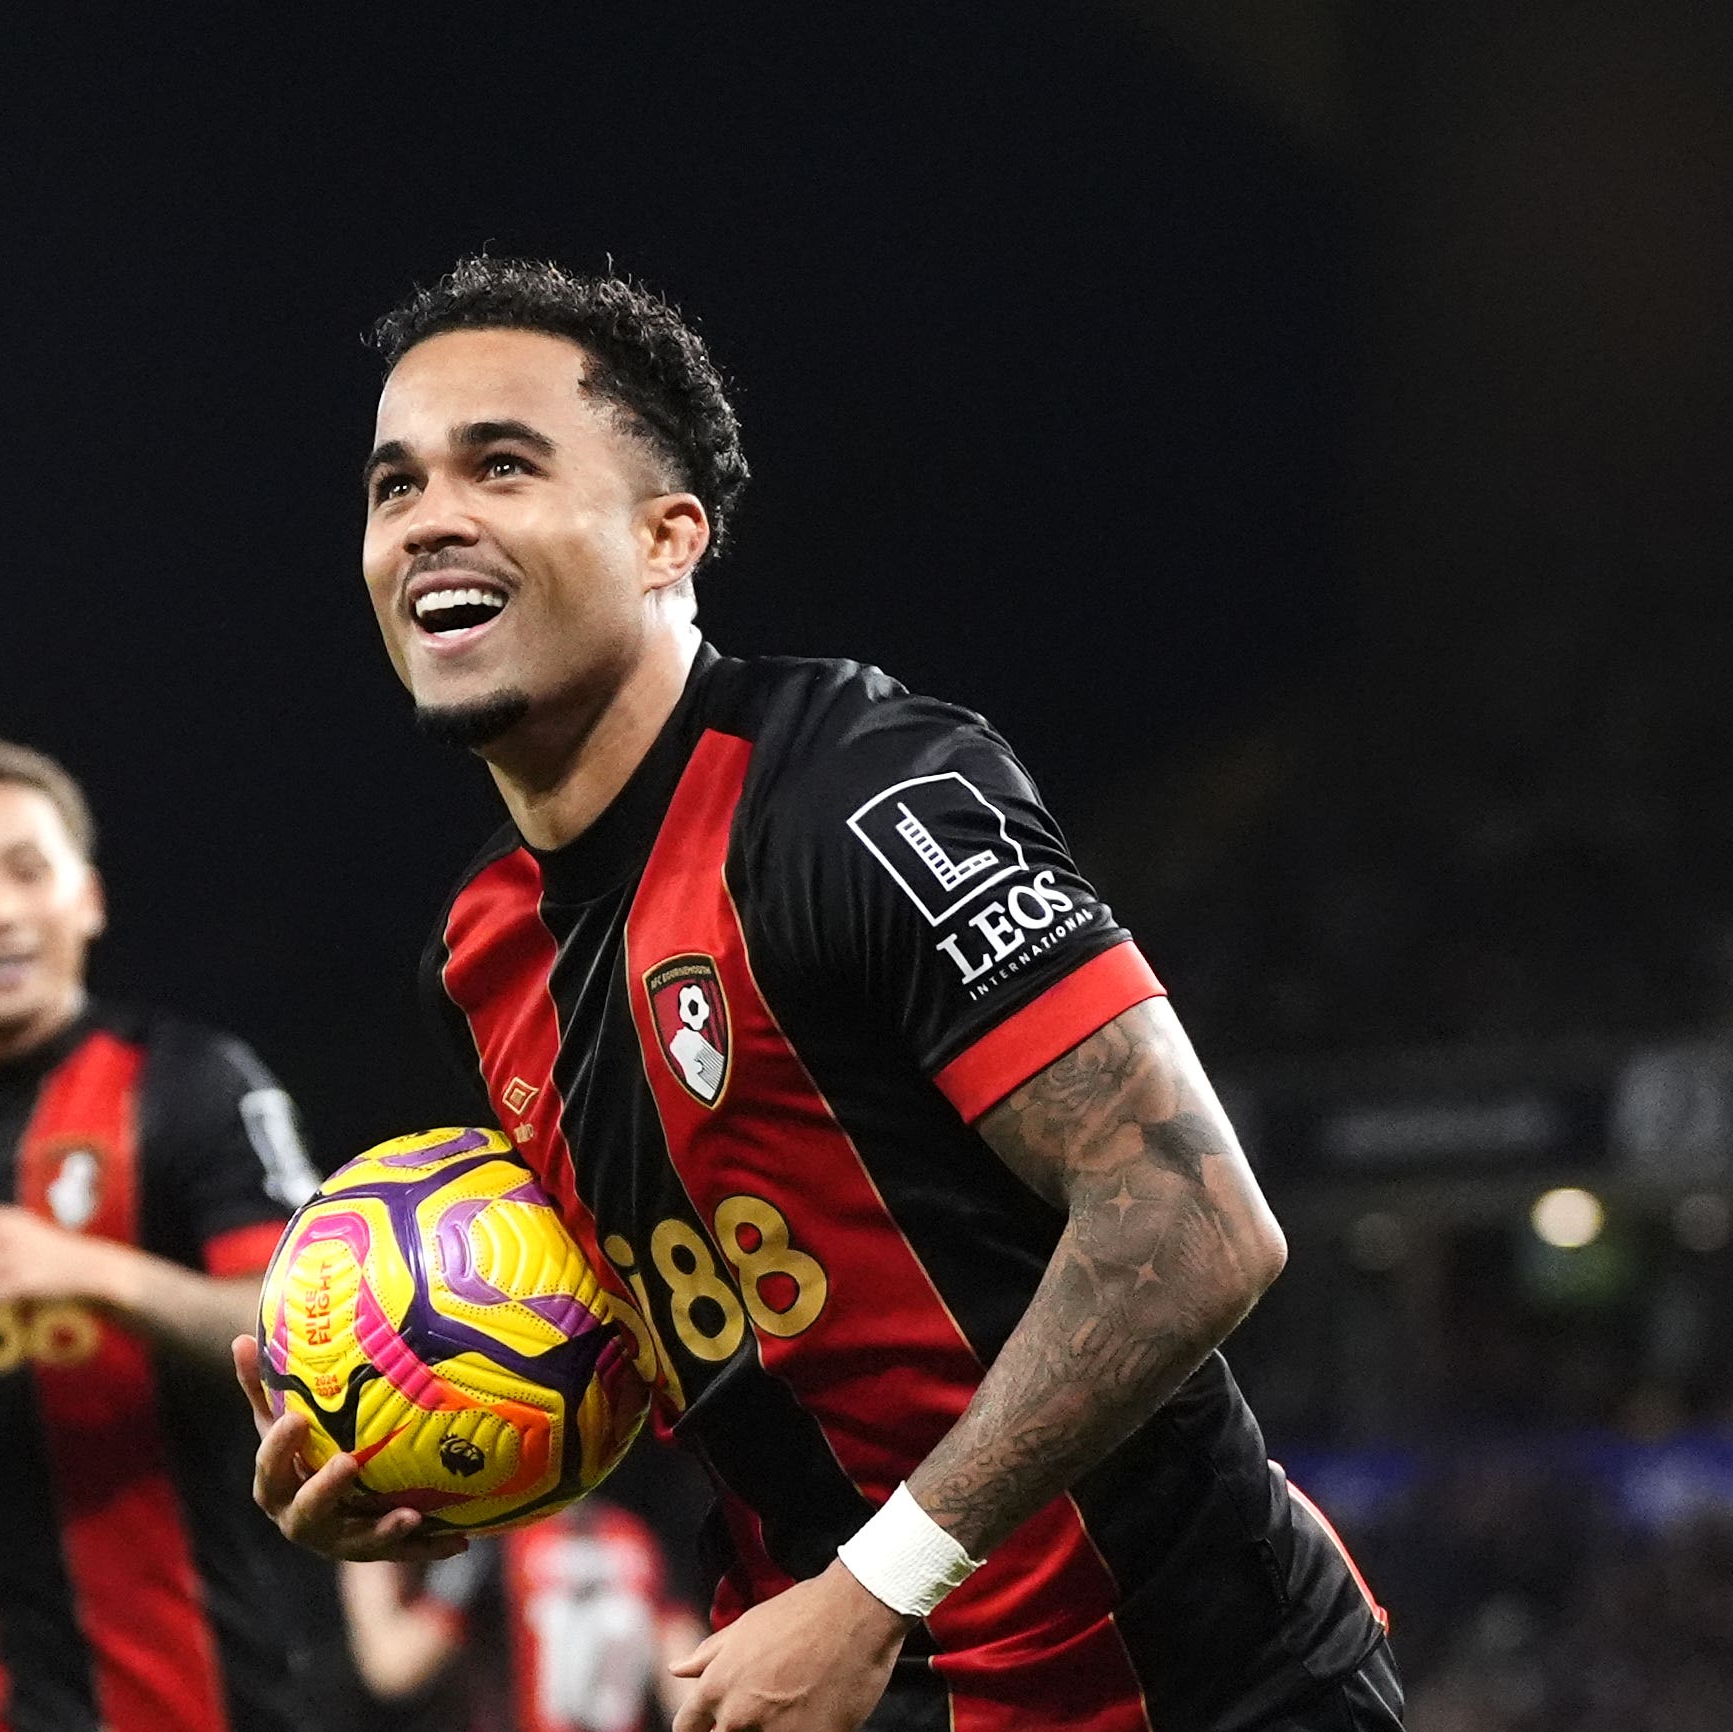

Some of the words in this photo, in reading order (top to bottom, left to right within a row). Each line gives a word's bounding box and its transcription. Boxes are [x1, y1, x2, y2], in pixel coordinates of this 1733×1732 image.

[936, 870, 1073, 986] LEOS
[968, 908, 1094, 1002] INTERNATIONAL
[650, 975, 663, 990] AFC
[305, 1288, 319, 1346] NIKE
[317, 1261, 333, 1347] FLIGHT
[314, 1374, 338, 1386] 2024
